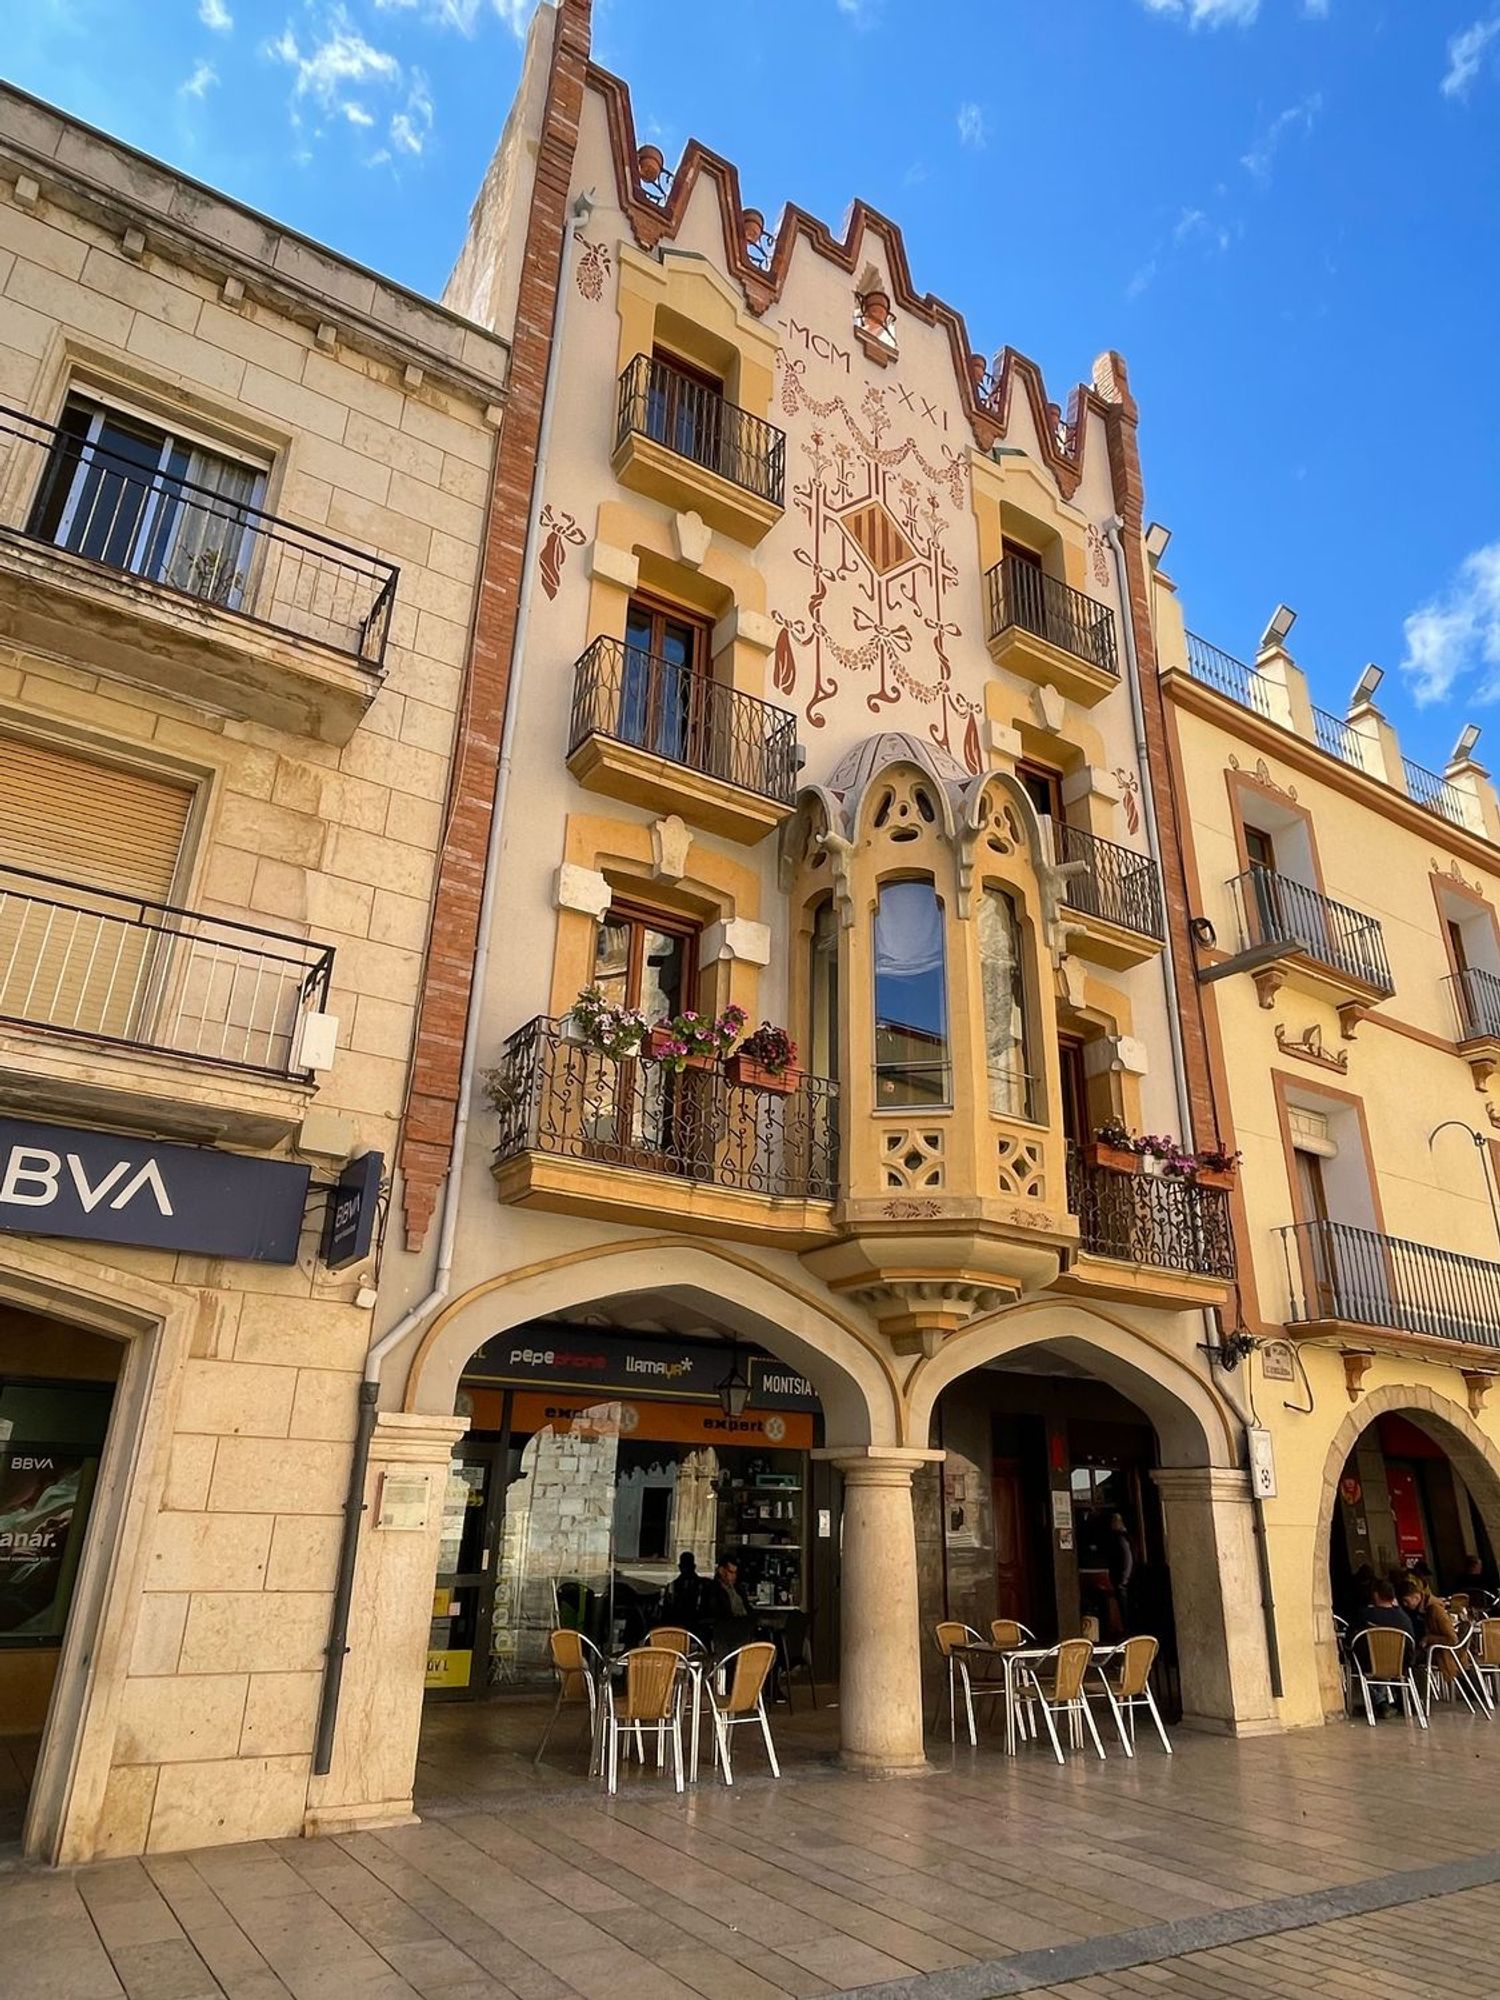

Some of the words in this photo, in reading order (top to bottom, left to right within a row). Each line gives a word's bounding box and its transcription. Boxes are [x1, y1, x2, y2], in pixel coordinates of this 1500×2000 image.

[335, 1191, 360, 1229] BBVA
[703, 1417, 764, 1433] expert
[10, 1456, 54, 1471] BBVA
